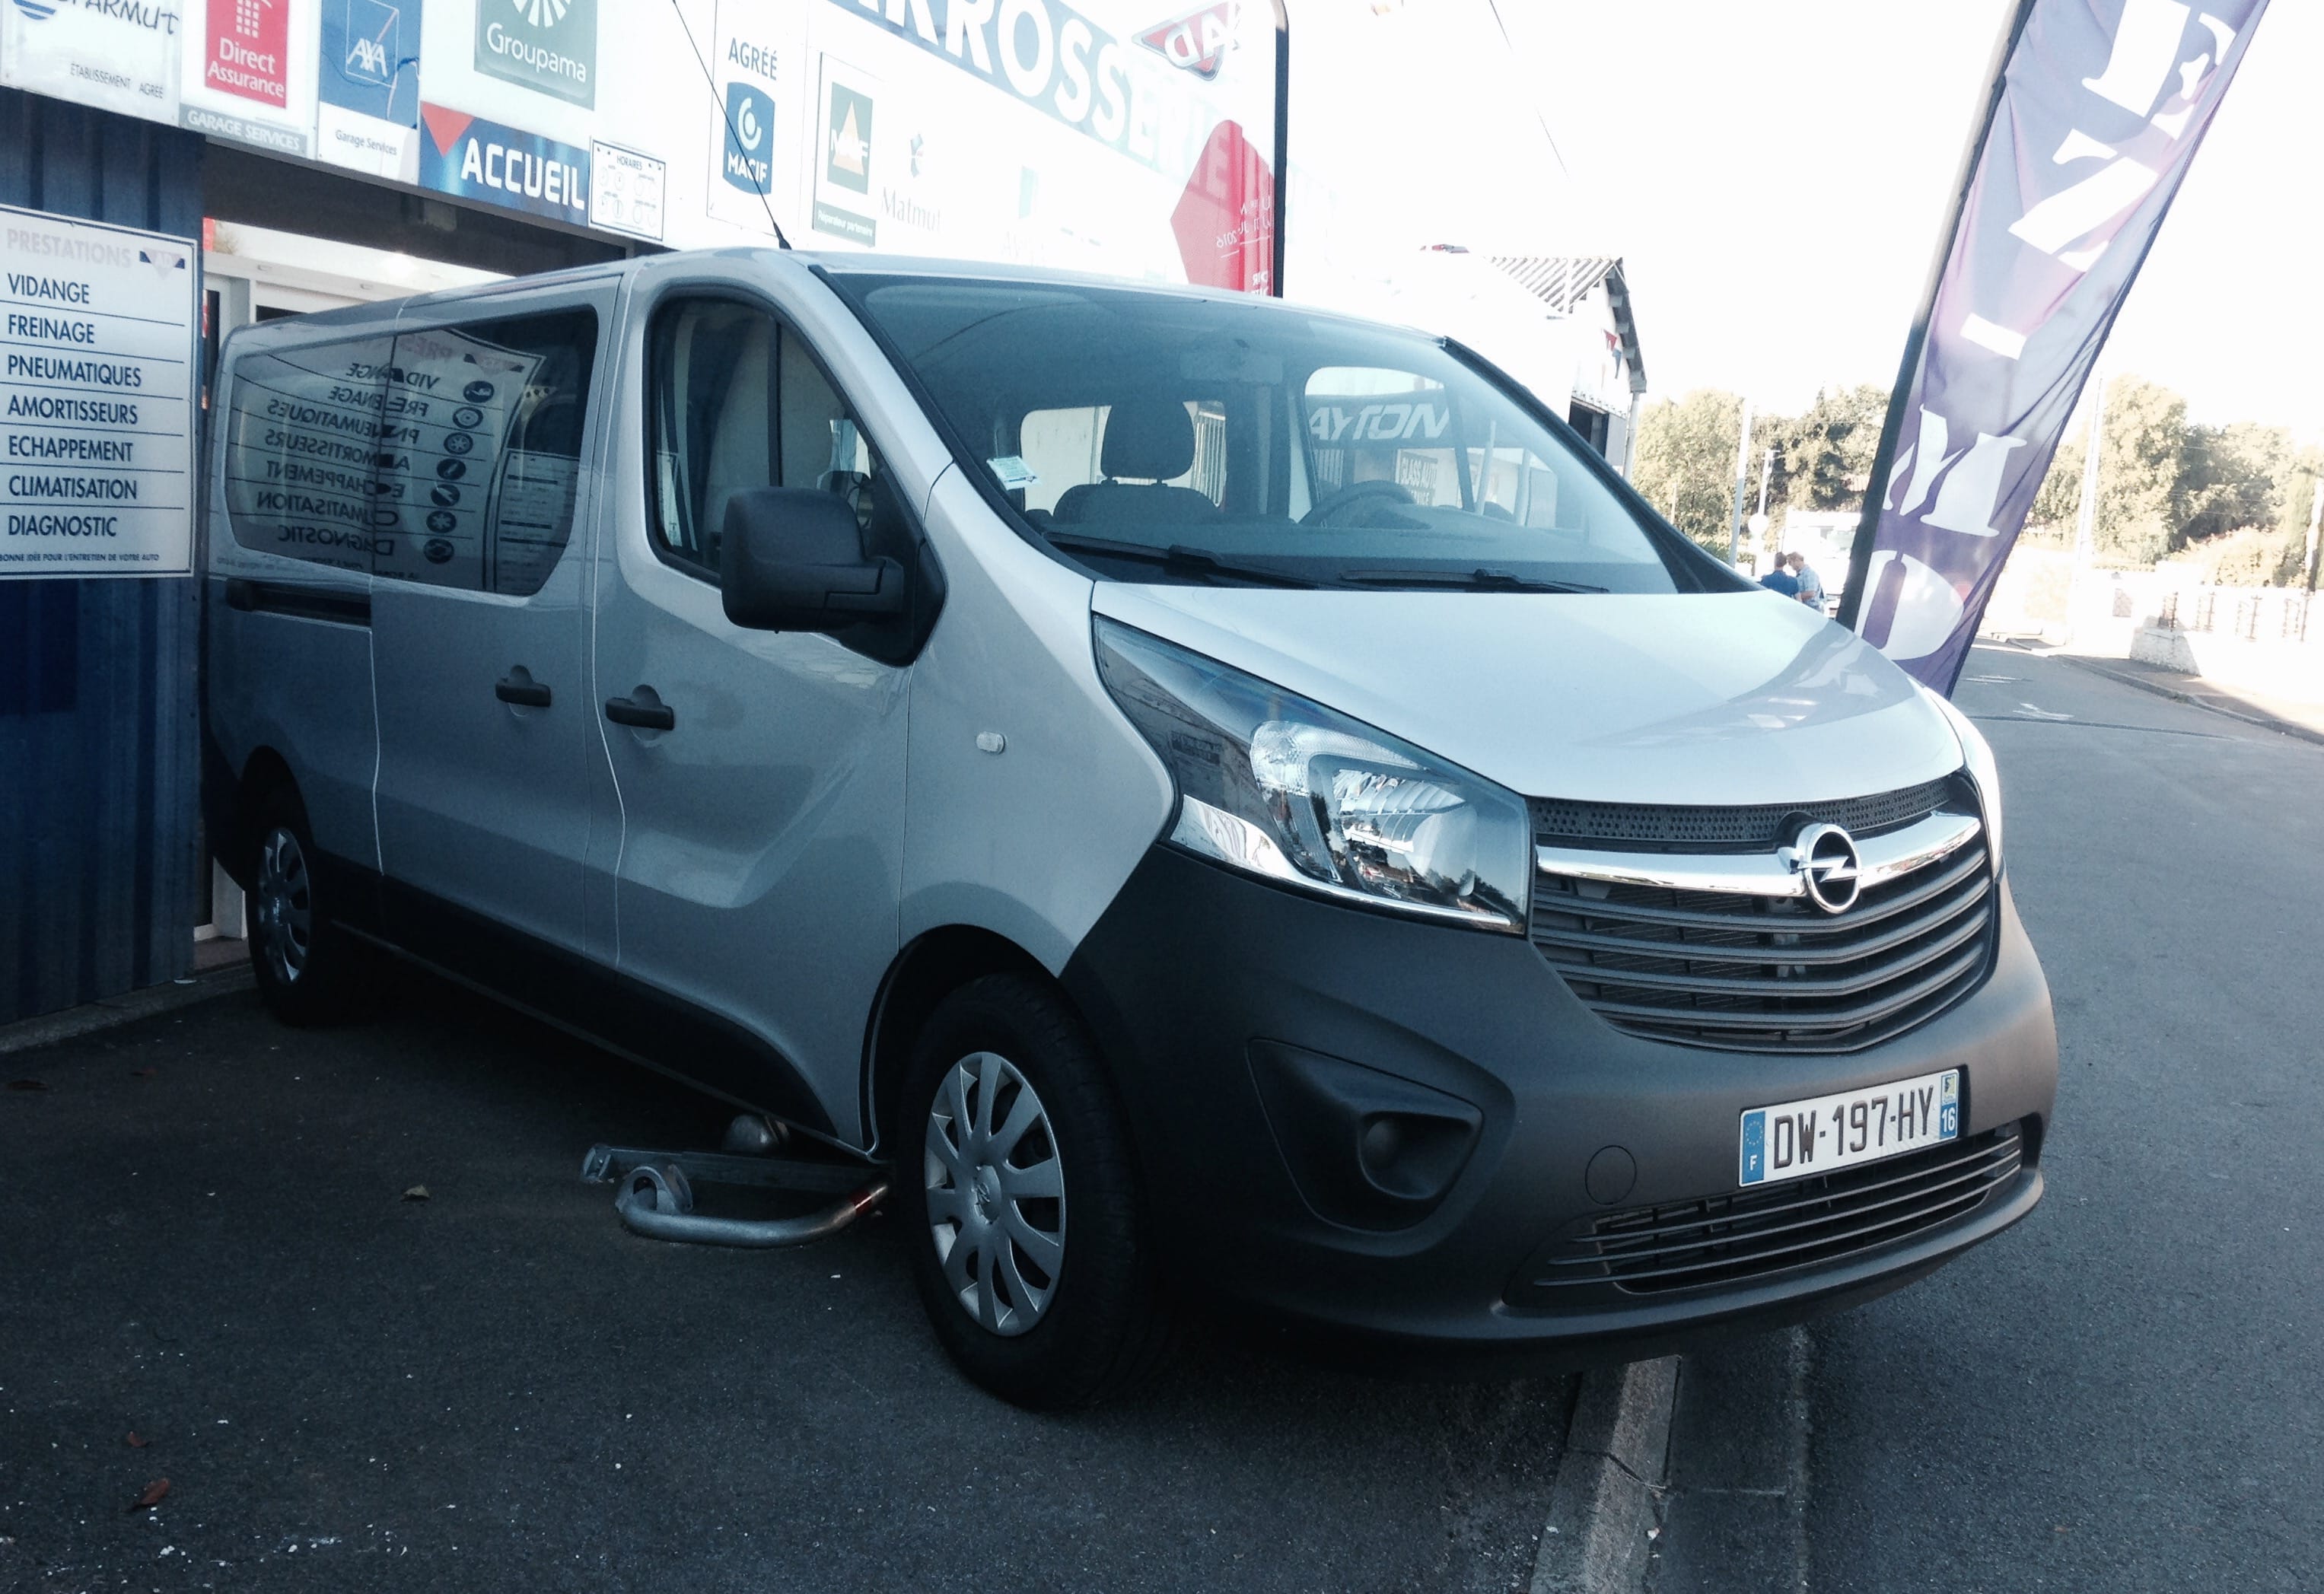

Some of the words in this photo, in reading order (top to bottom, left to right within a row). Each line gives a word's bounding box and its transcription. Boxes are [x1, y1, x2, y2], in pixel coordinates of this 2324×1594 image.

[219, 37, 275, 75] Direct
[346, 38, 388, 78] AXA
[486, 22, 587, 84] Groupama
[727, 37, 778, 81] AGRÉÉ
[207, 60, 285, 99] Assurance
[187, 110, 242, 138] GARAGE
[244, 121, 300, 151] SERVICES
[336, 129, 367, 148] Garage
[366, 135, 398, 156] Services
[460, 138, 585, 211] ACCUEIL
[727, 150, 768, 183] MACIF
[6, 228, 132, 268] PRESTATIONS
[8, 273, 90, 304] VIDANGE
[8, 314, 95, 344] FREINAGE
[8, 355, 142, 387] PNEUMATIQUES
[8, 395, 138, 425] AMORTISSEURS
[8, 435, 133, 462] ECHAPPEMENT
[8, 476, 137, 500] CLIMATISATION
[8, 515, 117, 537] DIAGNOSTIC
[1773, 1084, 1934, 1169] DW-197-HY
[1941, 1106, 1956, 1133] 16
[1750, 1154, 1757, 1171] F
